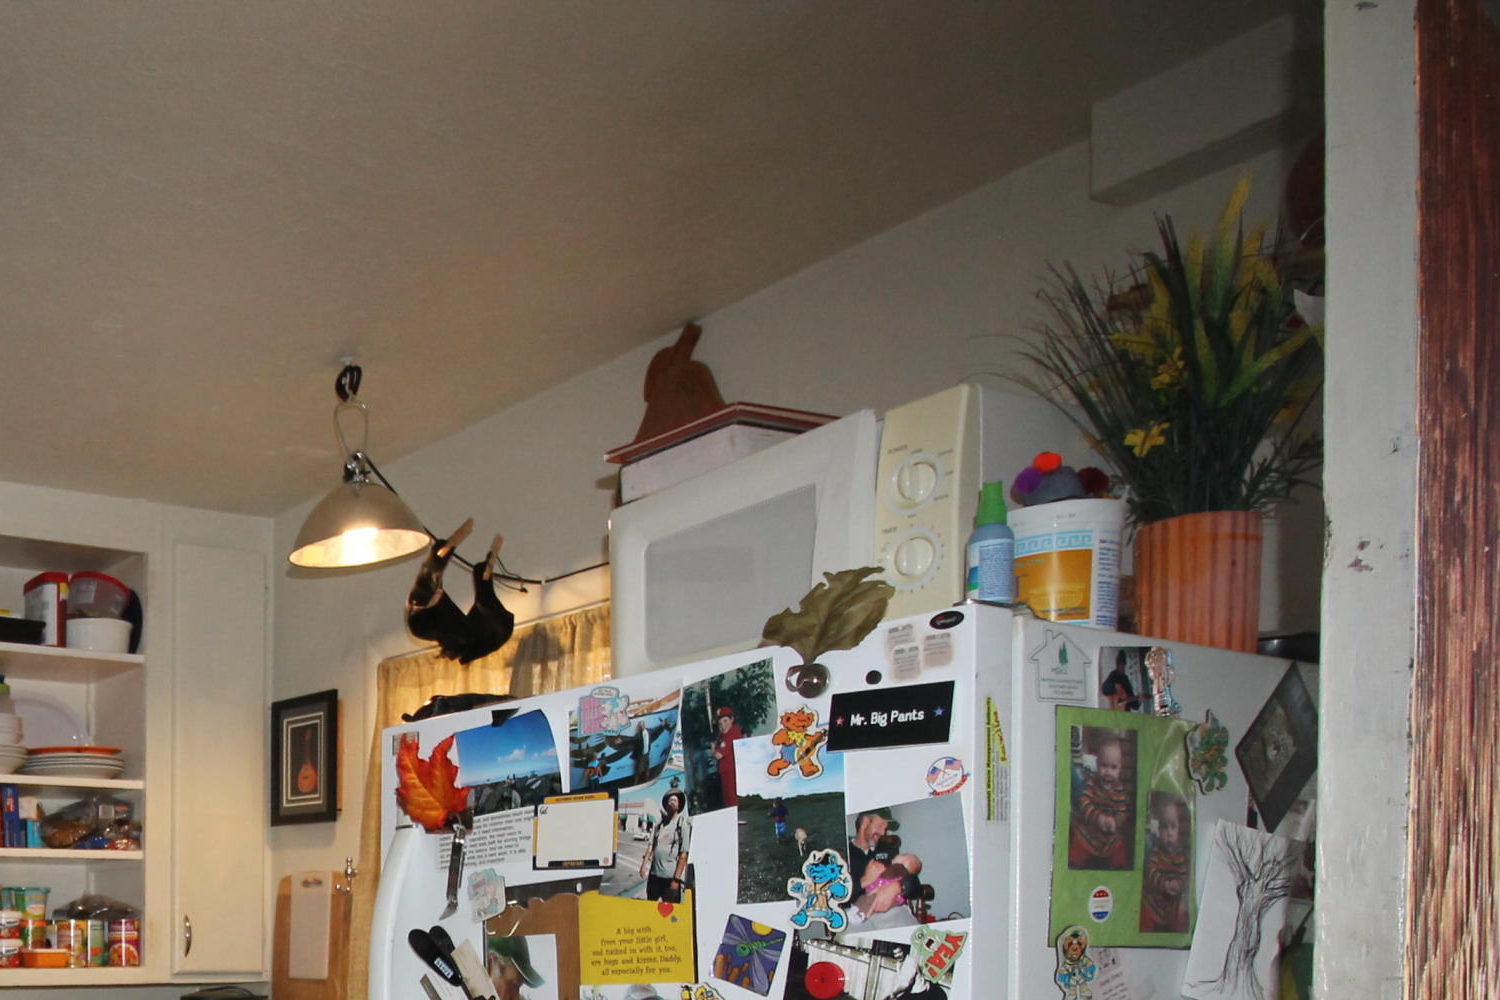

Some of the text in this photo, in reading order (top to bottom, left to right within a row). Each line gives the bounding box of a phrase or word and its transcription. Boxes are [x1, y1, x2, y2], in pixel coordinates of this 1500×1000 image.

[850, 709, 924, 727] Mr. Big Pants
[927, 934, 964, 978] YEA!
[611, 967, 644, 977] especially
